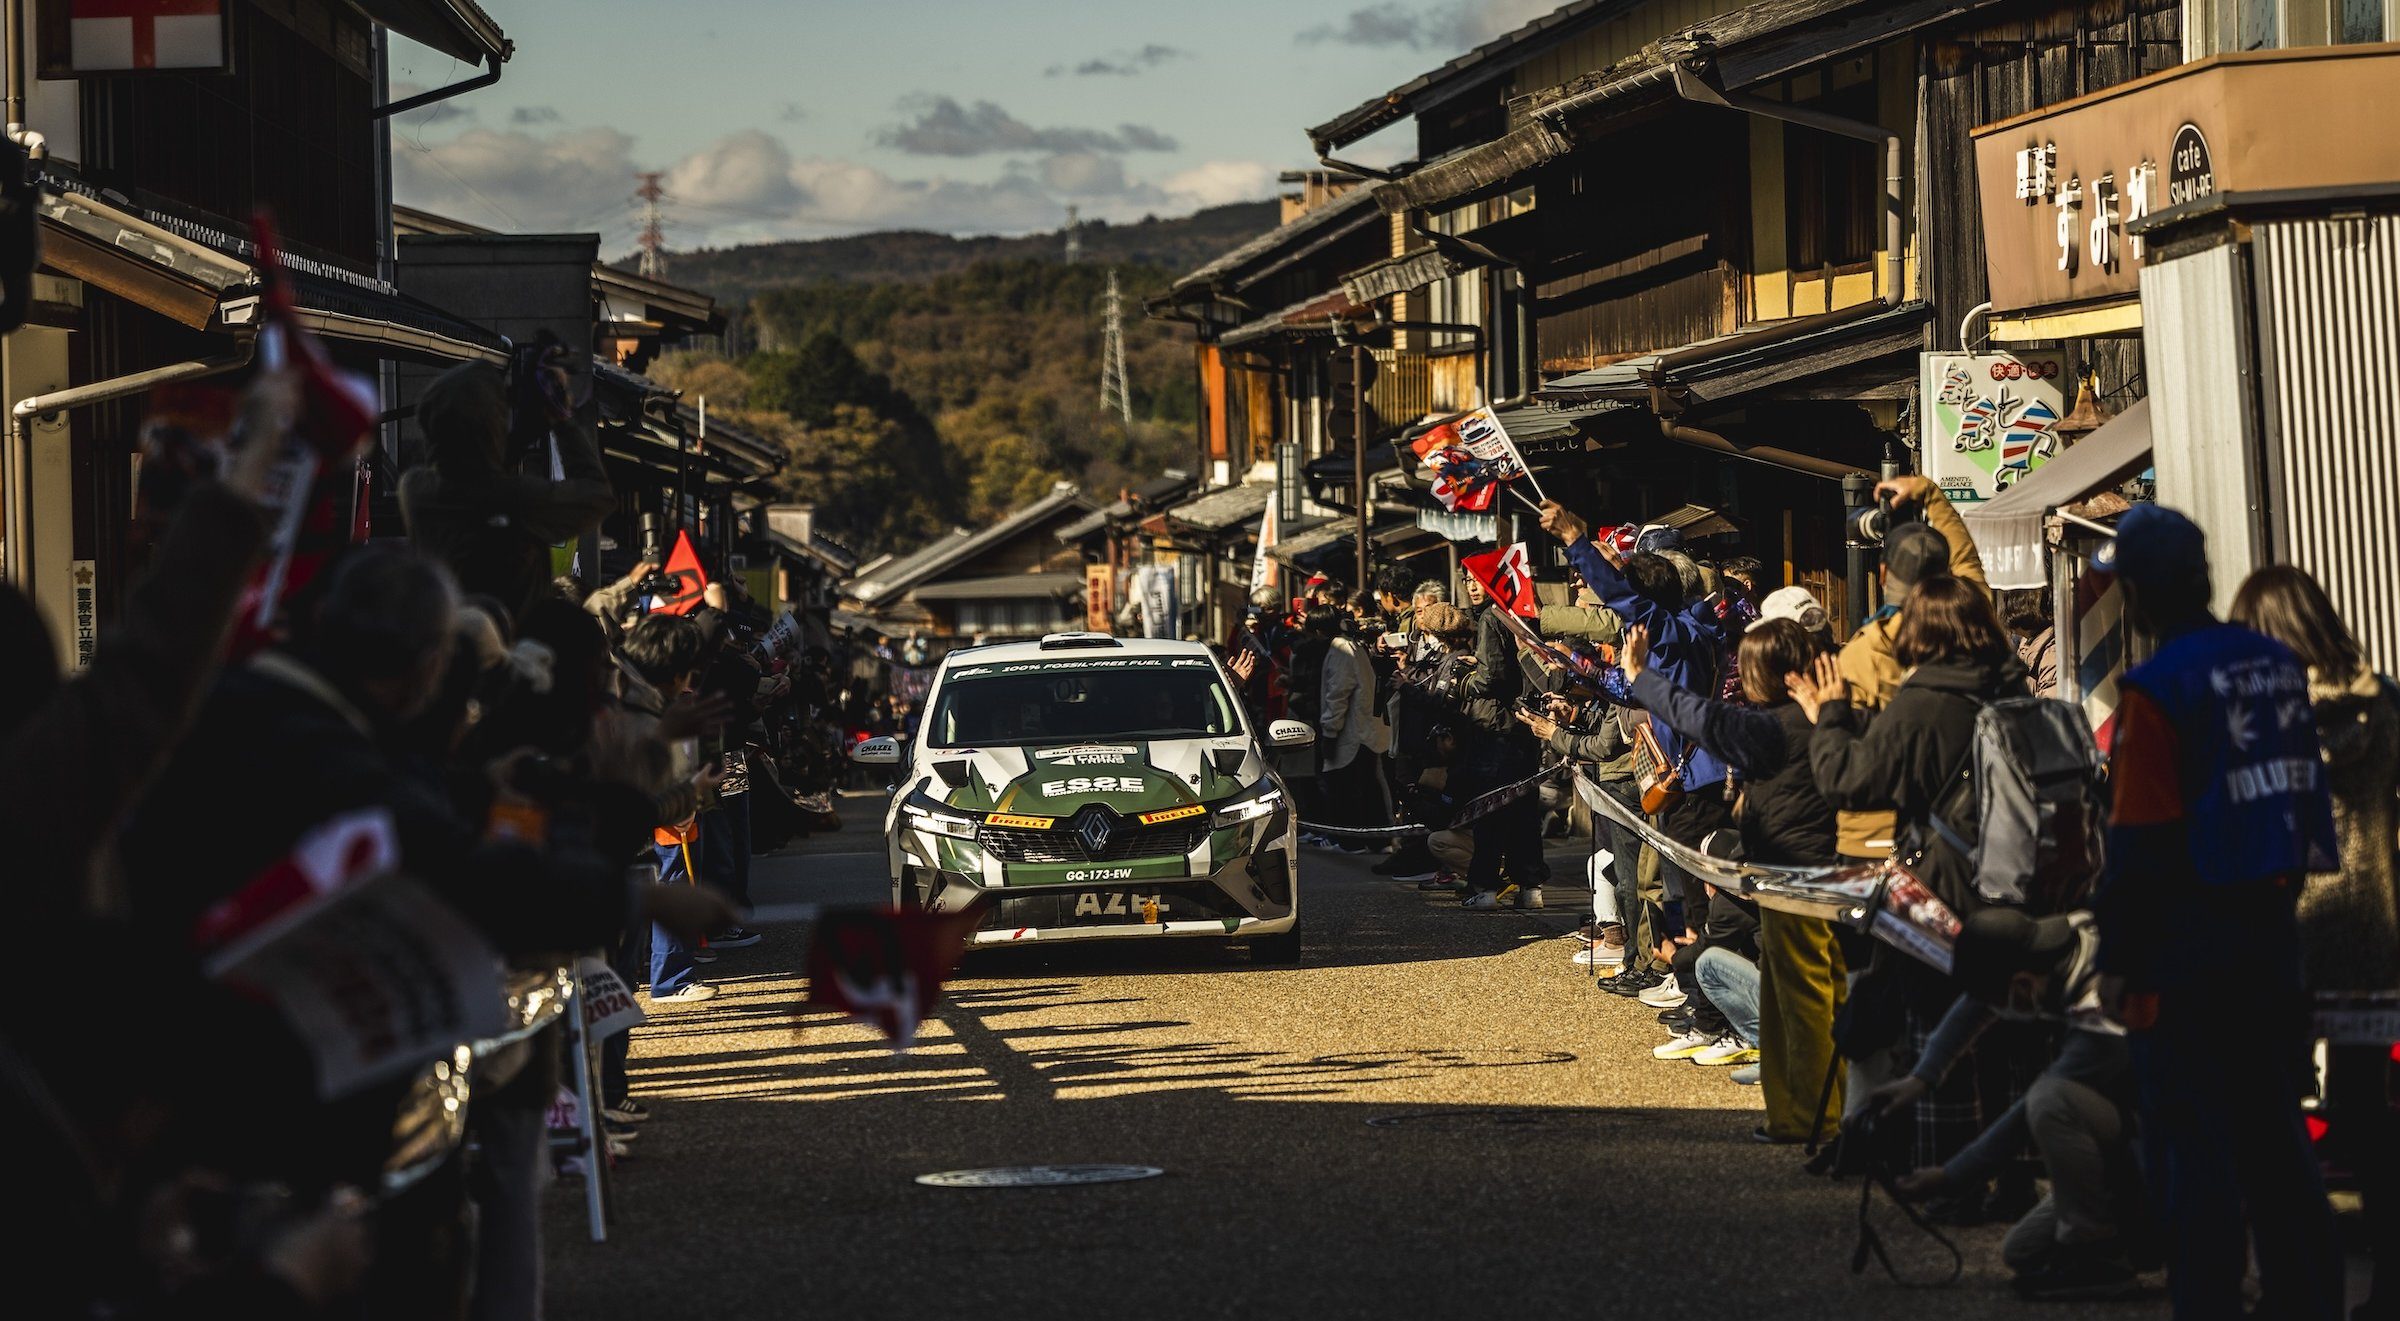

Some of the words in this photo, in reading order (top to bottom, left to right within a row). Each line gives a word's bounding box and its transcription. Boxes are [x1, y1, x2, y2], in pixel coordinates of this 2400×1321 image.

[2177, 140, 2201, 172] cafe
[77, 588, 93, 666] 警察官立寄所
[1002, 664, 1041, 672] 100%
[1043, 660, 1127, 669] FOSSIL-FREE
[1275, 727, 1306, 736] CHAZEL
[861, 744, 892, 753] CHAZEL
[1144, 805, 1200, 822] PIRELLI
[991, 815, 1047, 827] PIRELLI
[1066, 868, 1132, 881] GQ-173-EW
